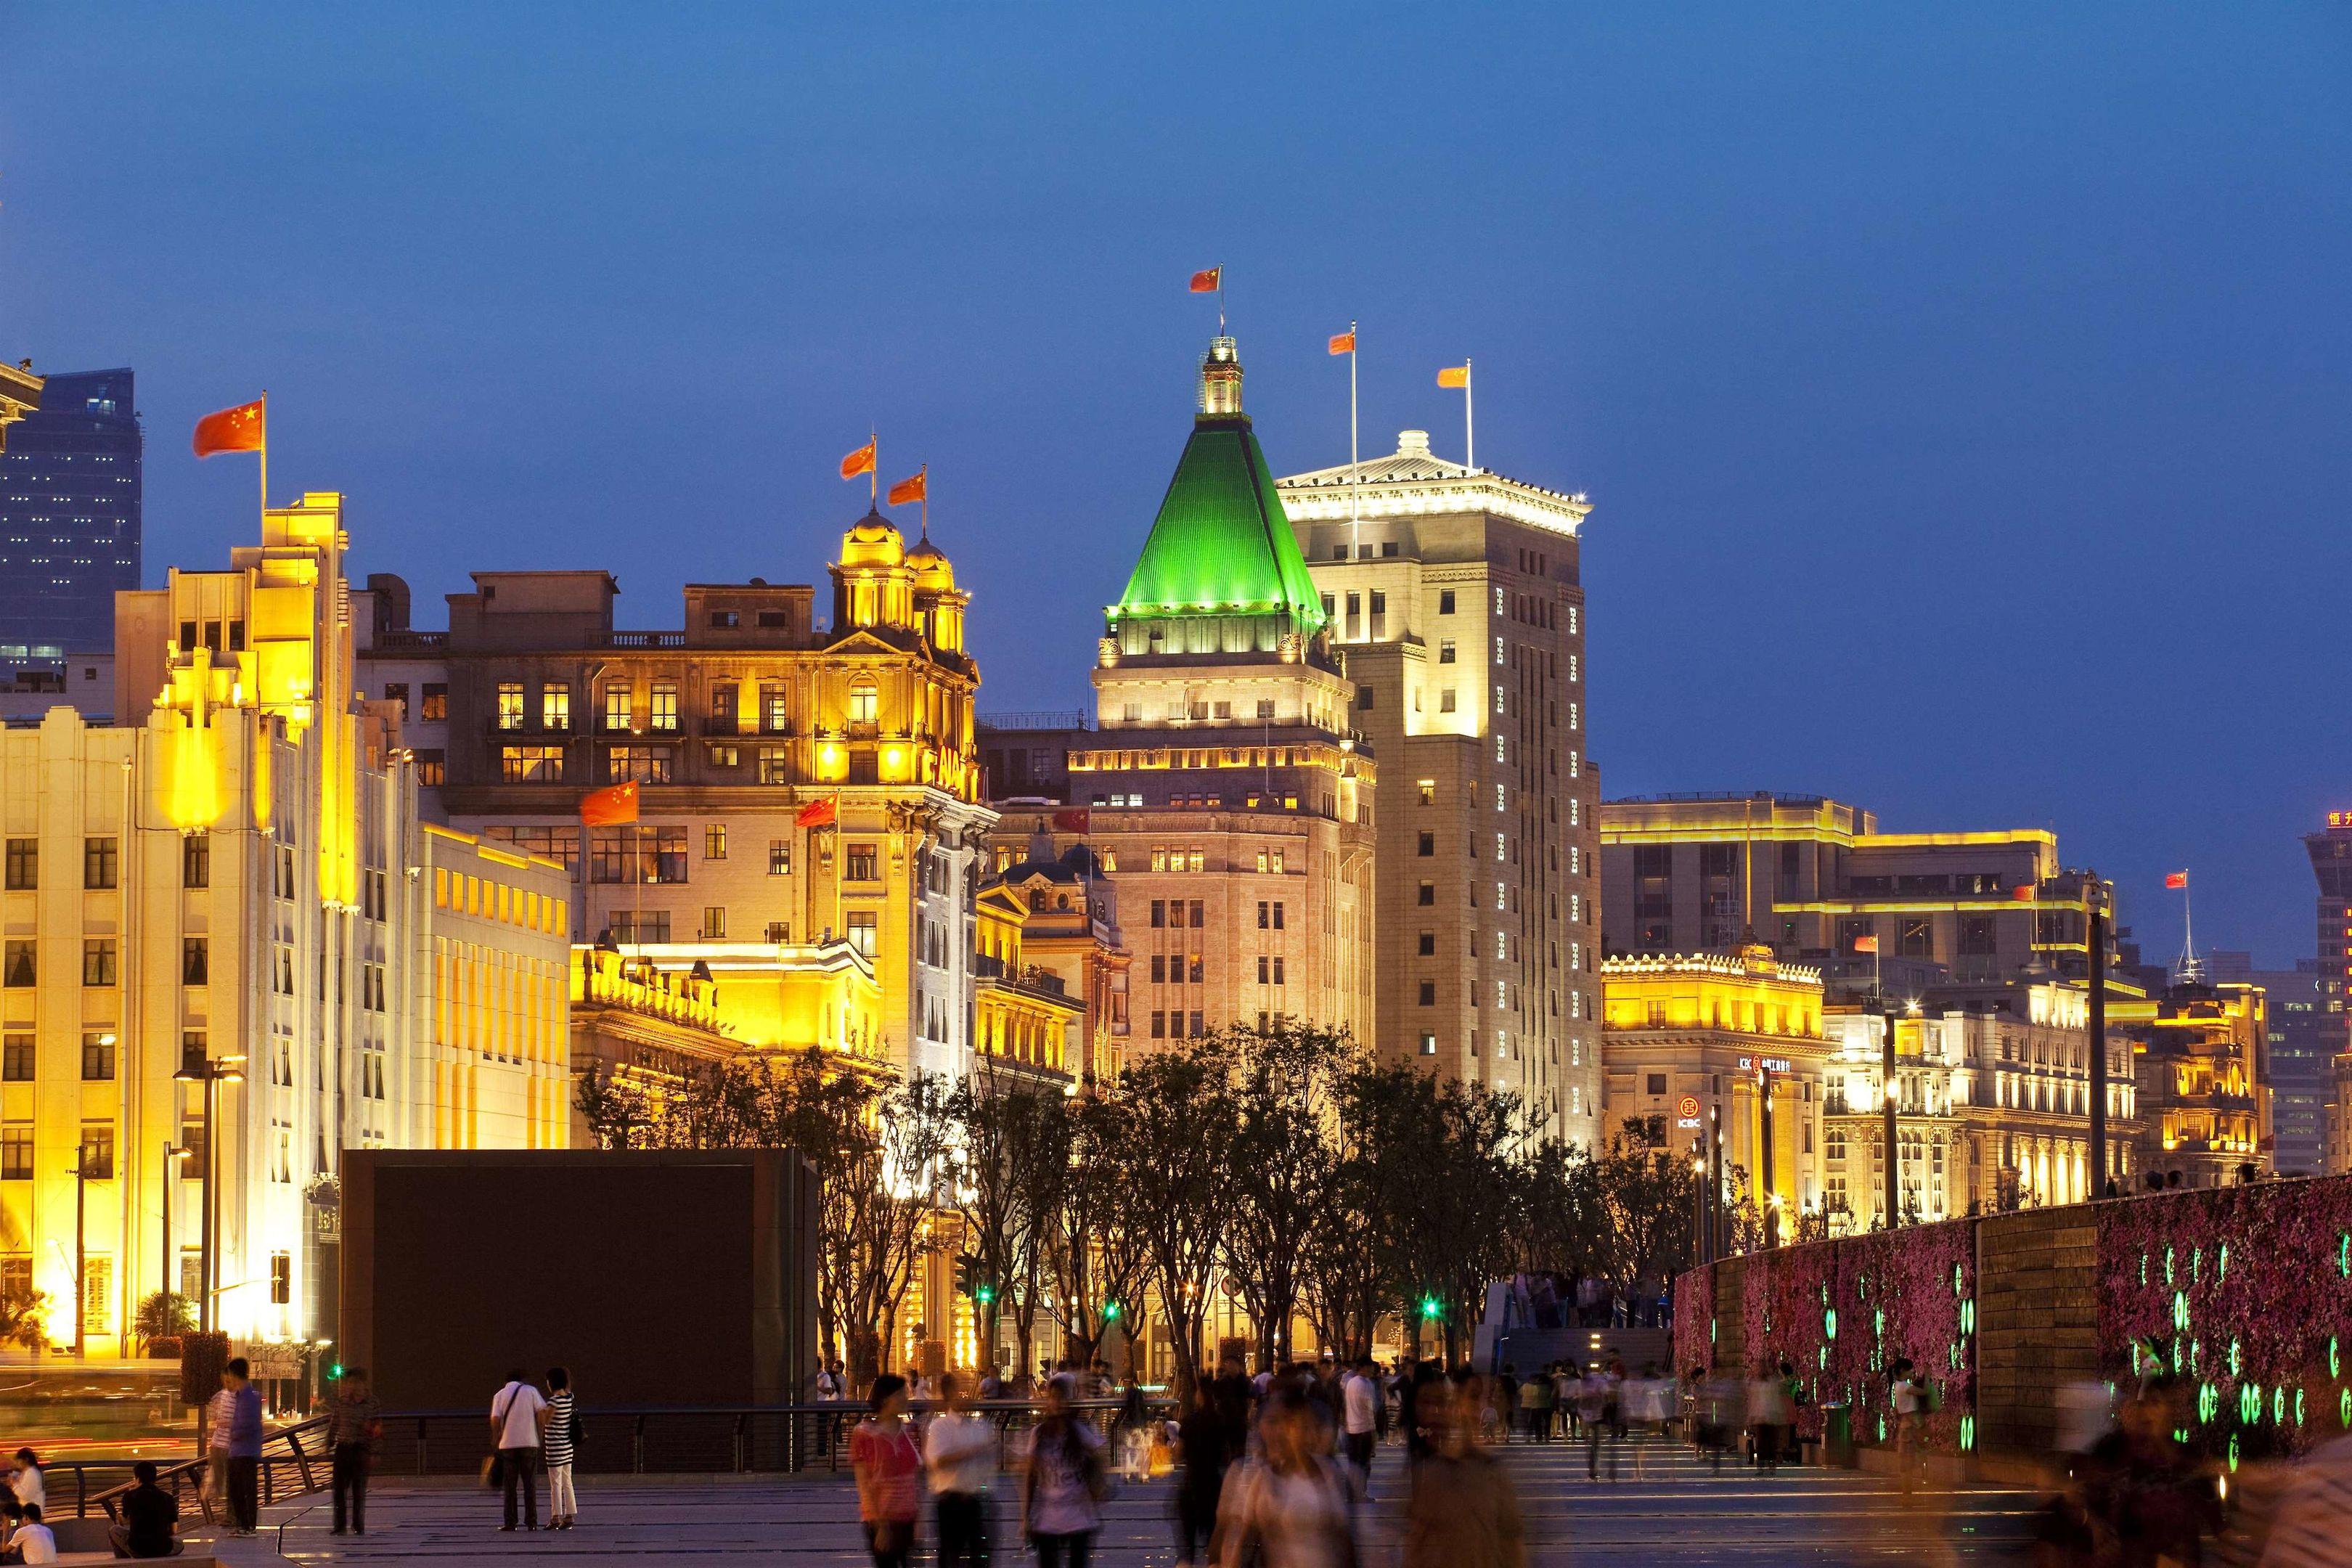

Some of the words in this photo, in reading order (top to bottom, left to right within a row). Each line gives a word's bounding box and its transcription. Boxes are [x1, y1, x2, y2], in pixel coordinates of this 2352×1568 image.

[938, 745, 962, 791] AIA
[1739, 1058, 1752, 1069] ICBC
[1678, 1119, 1701, 1128] ICBC
